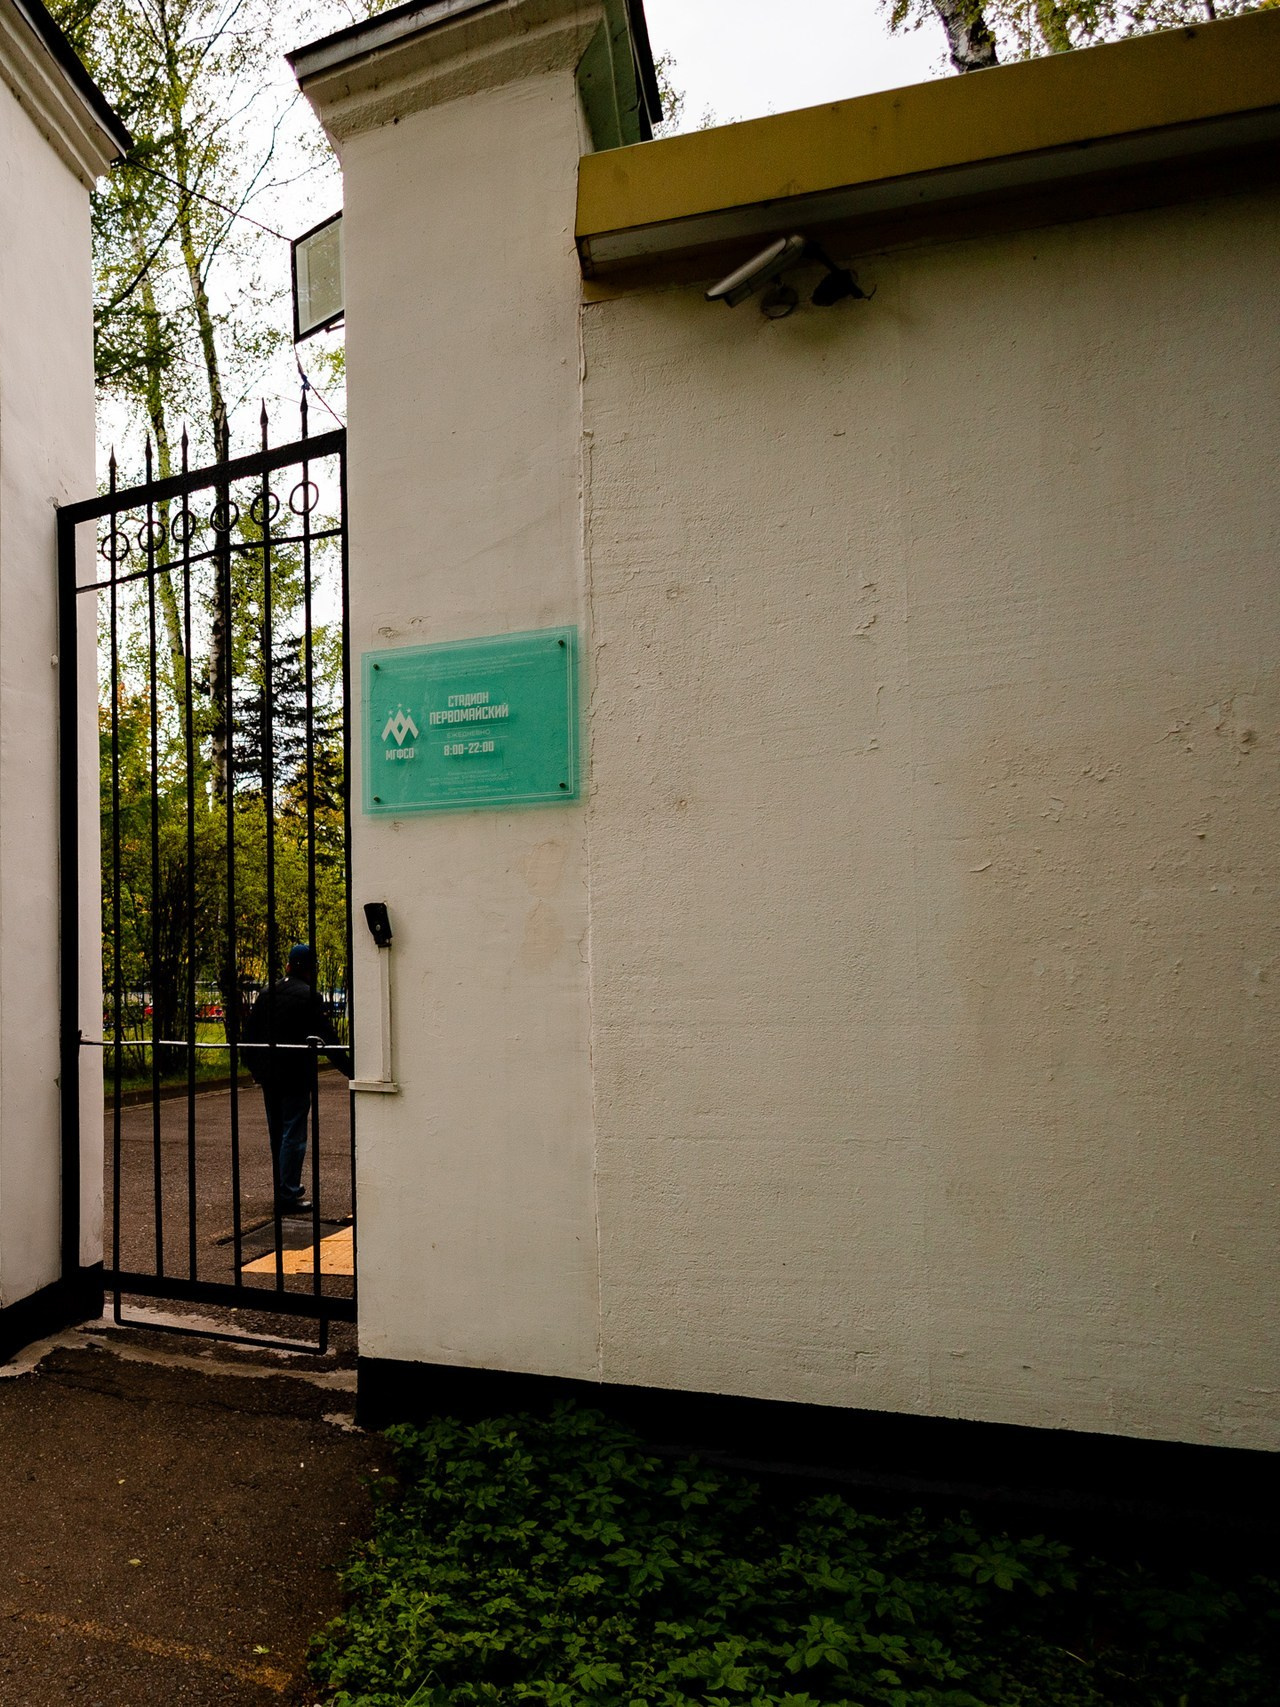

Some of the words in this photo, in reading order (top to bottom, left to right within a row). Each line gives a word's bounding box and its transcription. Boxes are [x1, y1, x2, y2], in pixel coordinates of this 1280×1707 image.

[448, 692, 489, 707] СТАДИОН
[430, 703, 509, 725] ПЕРВОМАЙСКИЙ
[385, 748, 414, 760] МГФСО
[444, 741, 494, 756] 8:00-22:00
